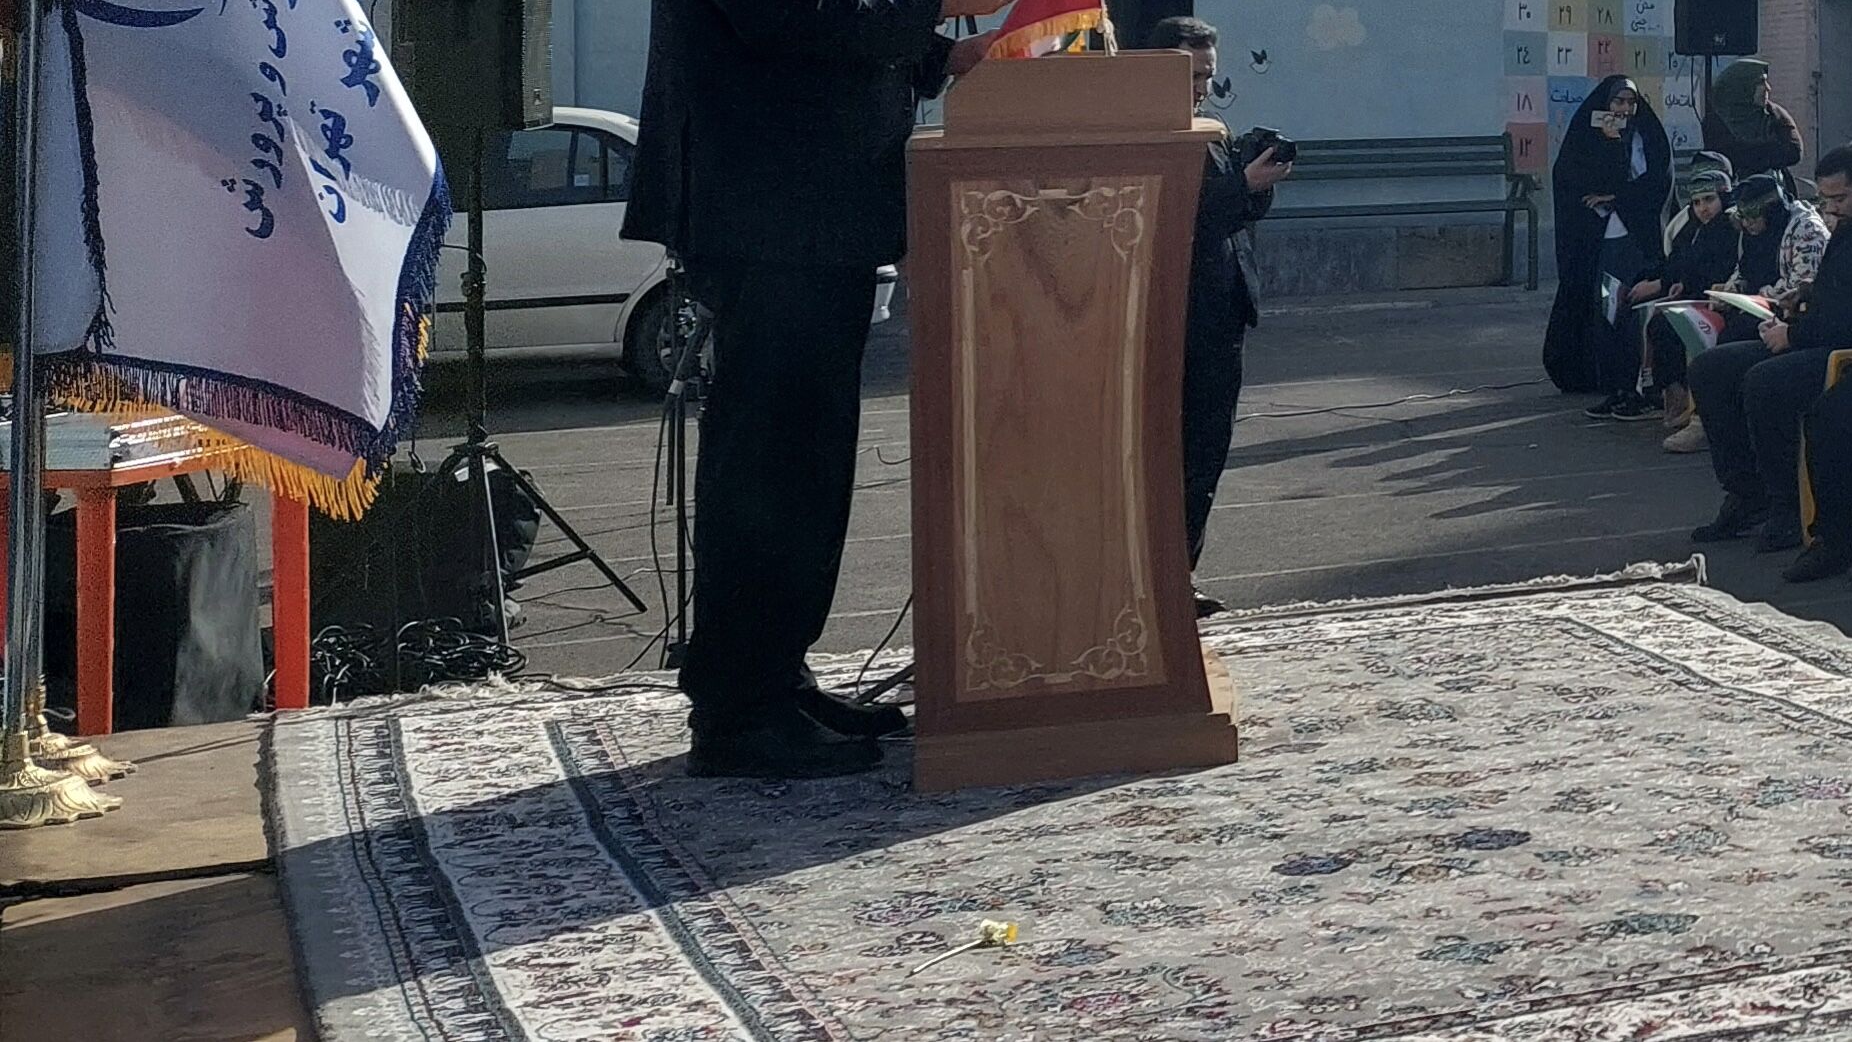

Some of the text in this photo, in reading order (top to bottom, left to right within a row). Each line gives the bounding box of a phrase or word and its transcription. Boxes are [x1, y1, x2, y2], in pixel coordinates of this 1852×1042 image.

[1558, 5, 1573, 26] ۲۹
[1596, 6, 1614, 25] ۲۸
[259, 61, 287, 96] و
[1516, 92, 1533, 111] ۱۸
[220, 92, 290, 240] پرورش
[309, 100, 354, 225] تهران
